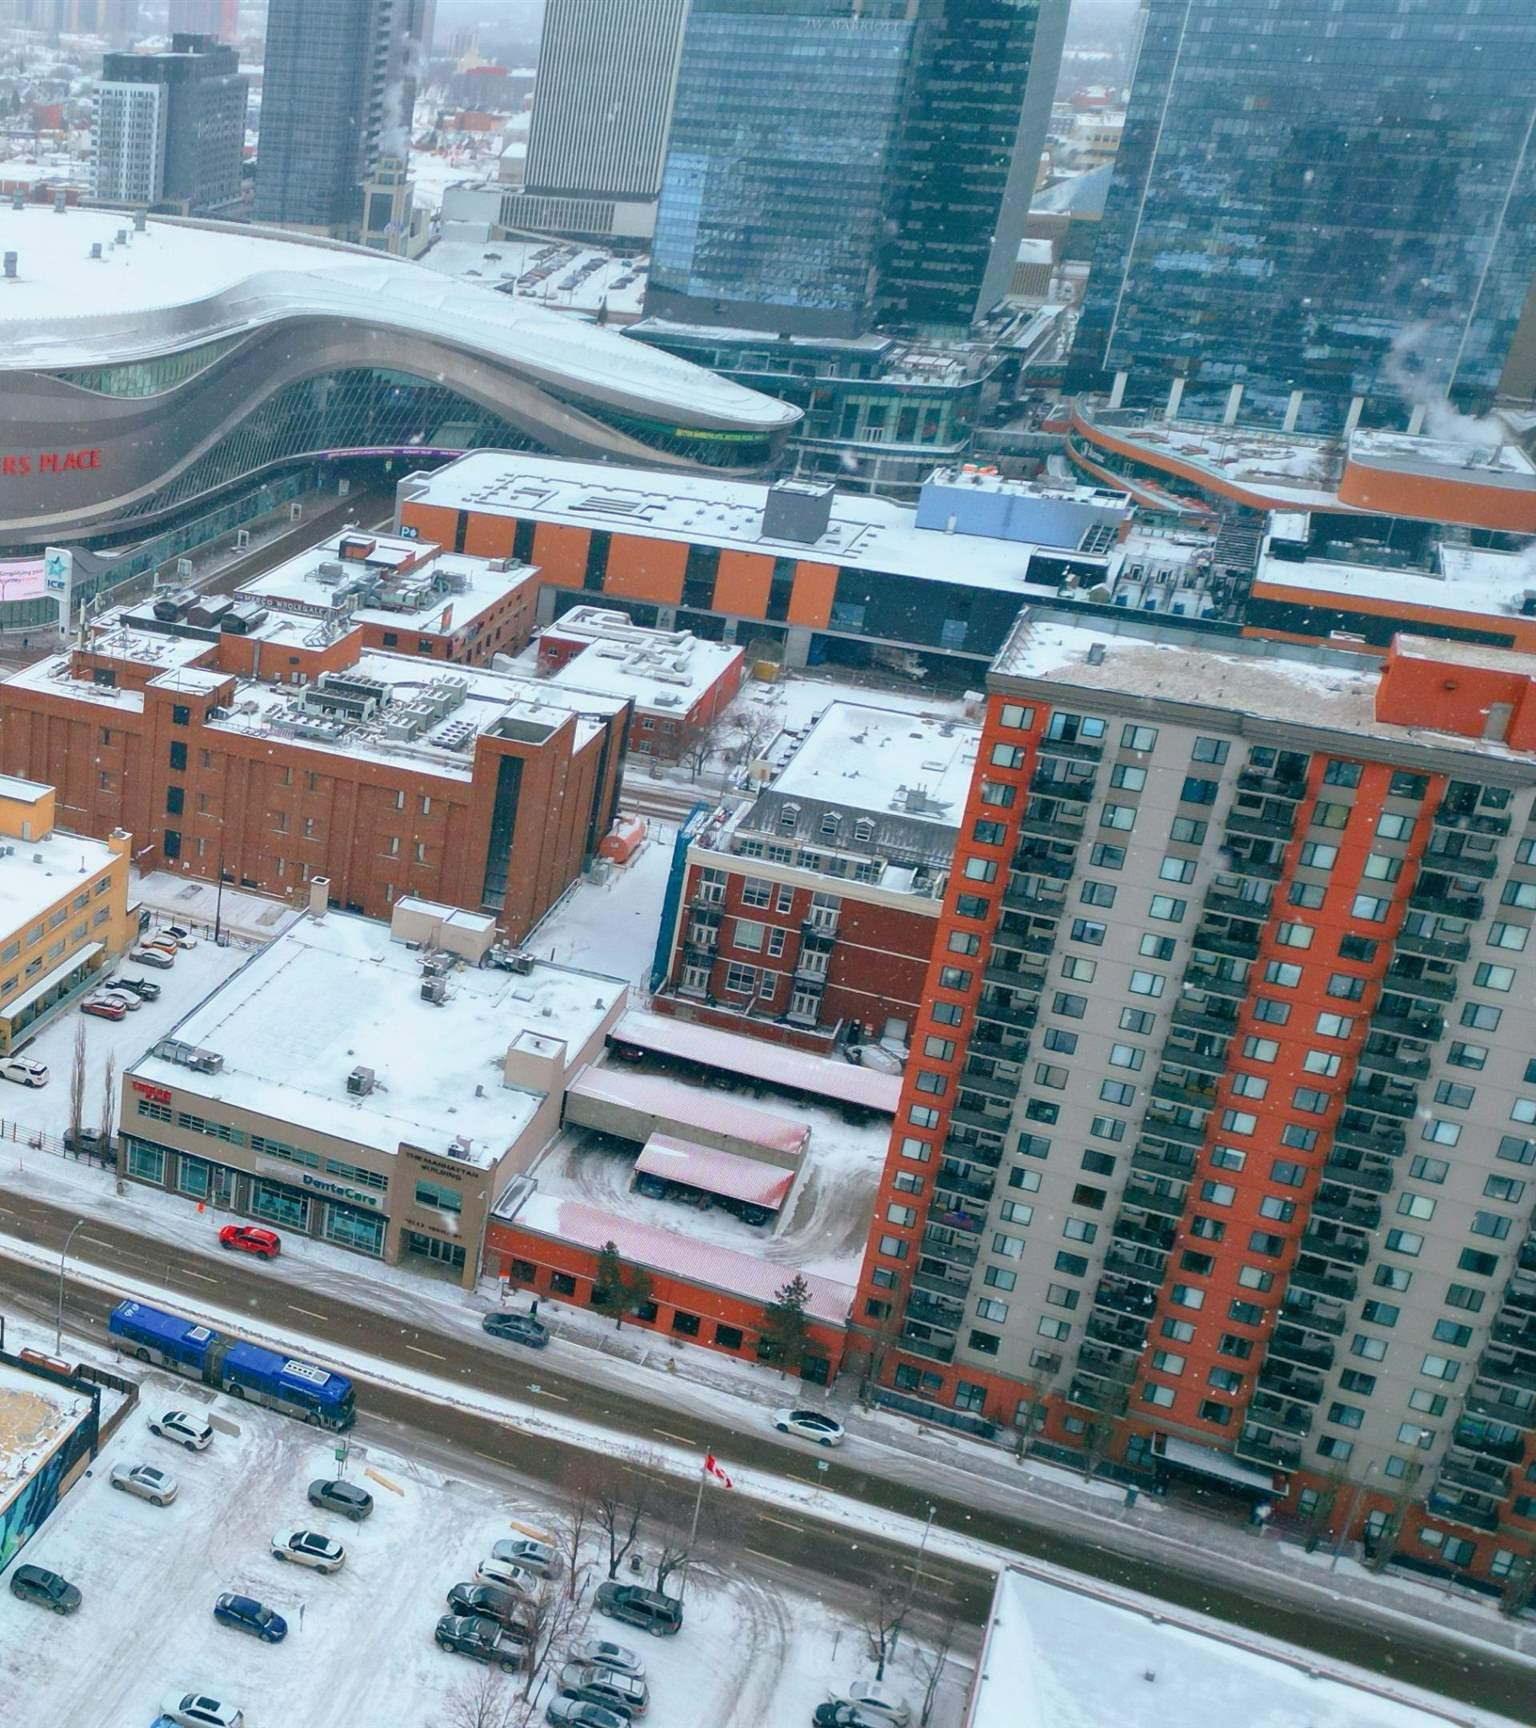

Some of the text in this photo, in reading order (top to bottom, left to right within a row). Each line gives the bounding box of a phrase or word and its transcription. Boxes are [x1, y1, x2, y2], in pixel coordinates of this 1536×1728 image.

[39, 448, 103, 473] PLACE
[47, 579, 65, 590] ICE
[302, 1174, 378, 1206] DentaCare
